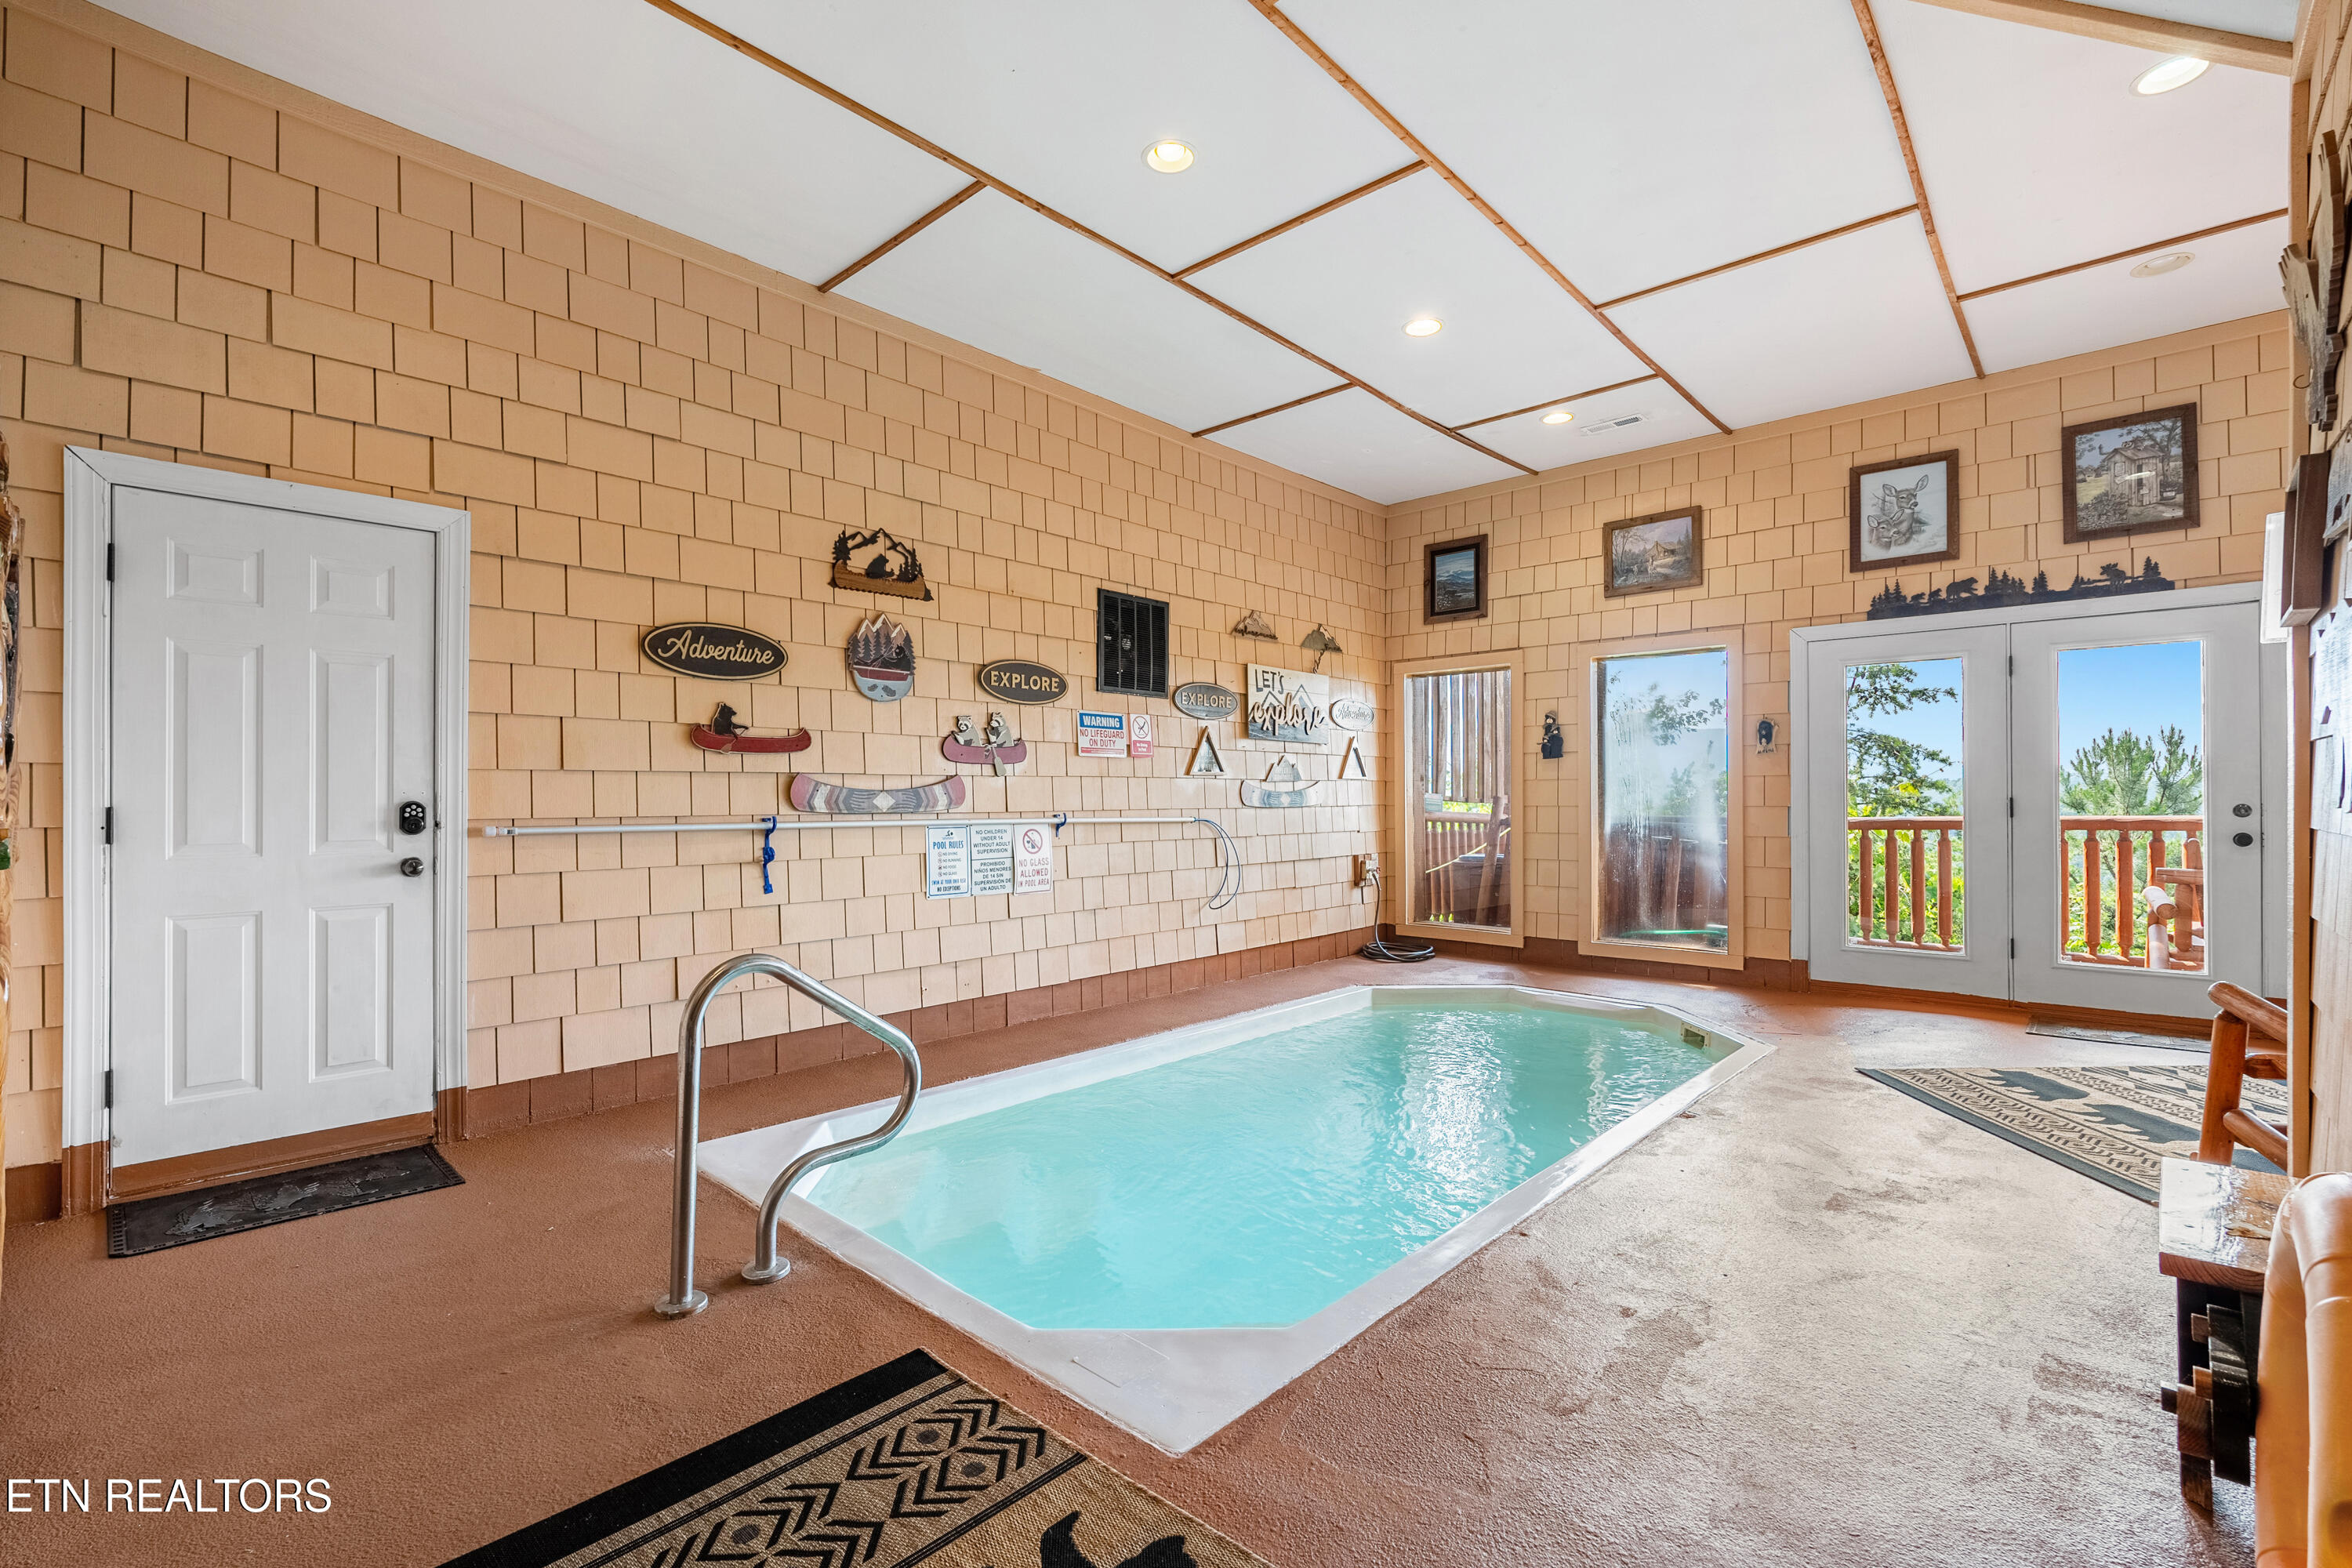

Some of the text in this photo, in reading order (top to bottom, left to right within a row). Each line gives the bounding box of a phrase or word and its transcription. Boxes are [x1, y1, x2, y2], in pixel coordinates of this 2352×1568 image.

[658, 630, 775, 664] Adventure
[990, 670, 1059, 692] EXPLORE
[1255, 669, 1284, 695] LET'S
[1181, 691, 1232, 710] EXPLORE
[1083, 715, 1120, 728] WARNING
[1248, 692, 1326, 735] explore
[1091, 730, 1124, 739] LIFEGUARD
[933, 840, 964, 850] POOL RULES
[1029, 858, 1049, 866] GLASS
[1021, 868, 1048, 878] ALLOWED
